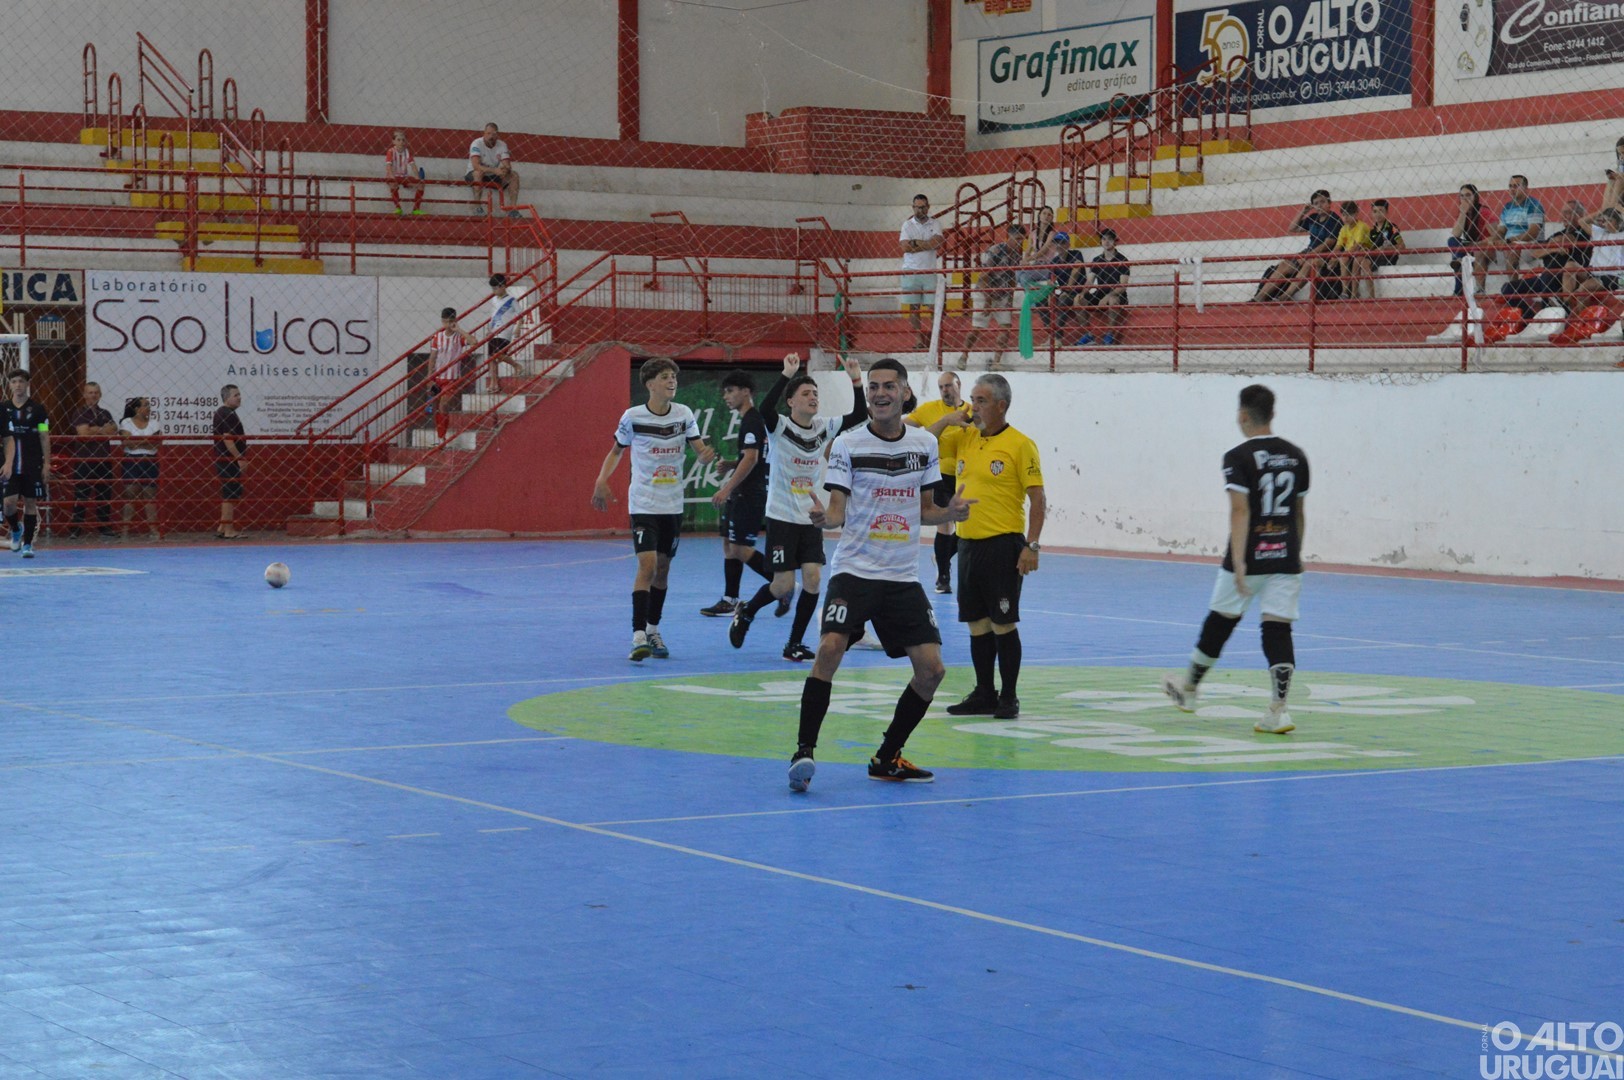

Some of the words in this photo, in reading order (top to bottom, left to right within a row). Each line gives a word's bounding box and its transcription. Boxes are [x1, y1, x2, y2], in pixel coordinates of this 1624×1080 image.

[1256, 8, 1265, 49] JORNAL
[1268, 5, 1293, 45] O
[1295, 0, 1381, 42] ALTO
[1221, 39, 1241, 51] anos
[1543, 42, 1565, 53] Fone:
[1254, 35, 1381, 80] URUGUAI
[989, 38, 1140, 98] Grafimax
[1067, 77, 1100, 92] editora
[1103, 73, 1137, 91] gráfica
[1314, 81, 1332, 96] (55)
[91, 277, 208, 293] Laboratório
[92, 299, 207, 353] São
[226, 364, 300, 378] Análises
[304, 364, 370, 378] clínicas
[164, 397, 219, 407] 3744-4988
[173, 424, 214, 434] 9716.09
[876, 486, 915, 498] Barril
[1257, 470, 1296, 516] 12
[636, 529, 645, 545] 7
[772, 550, 785, 564] 21
[825, 603, 848, 624] 20
